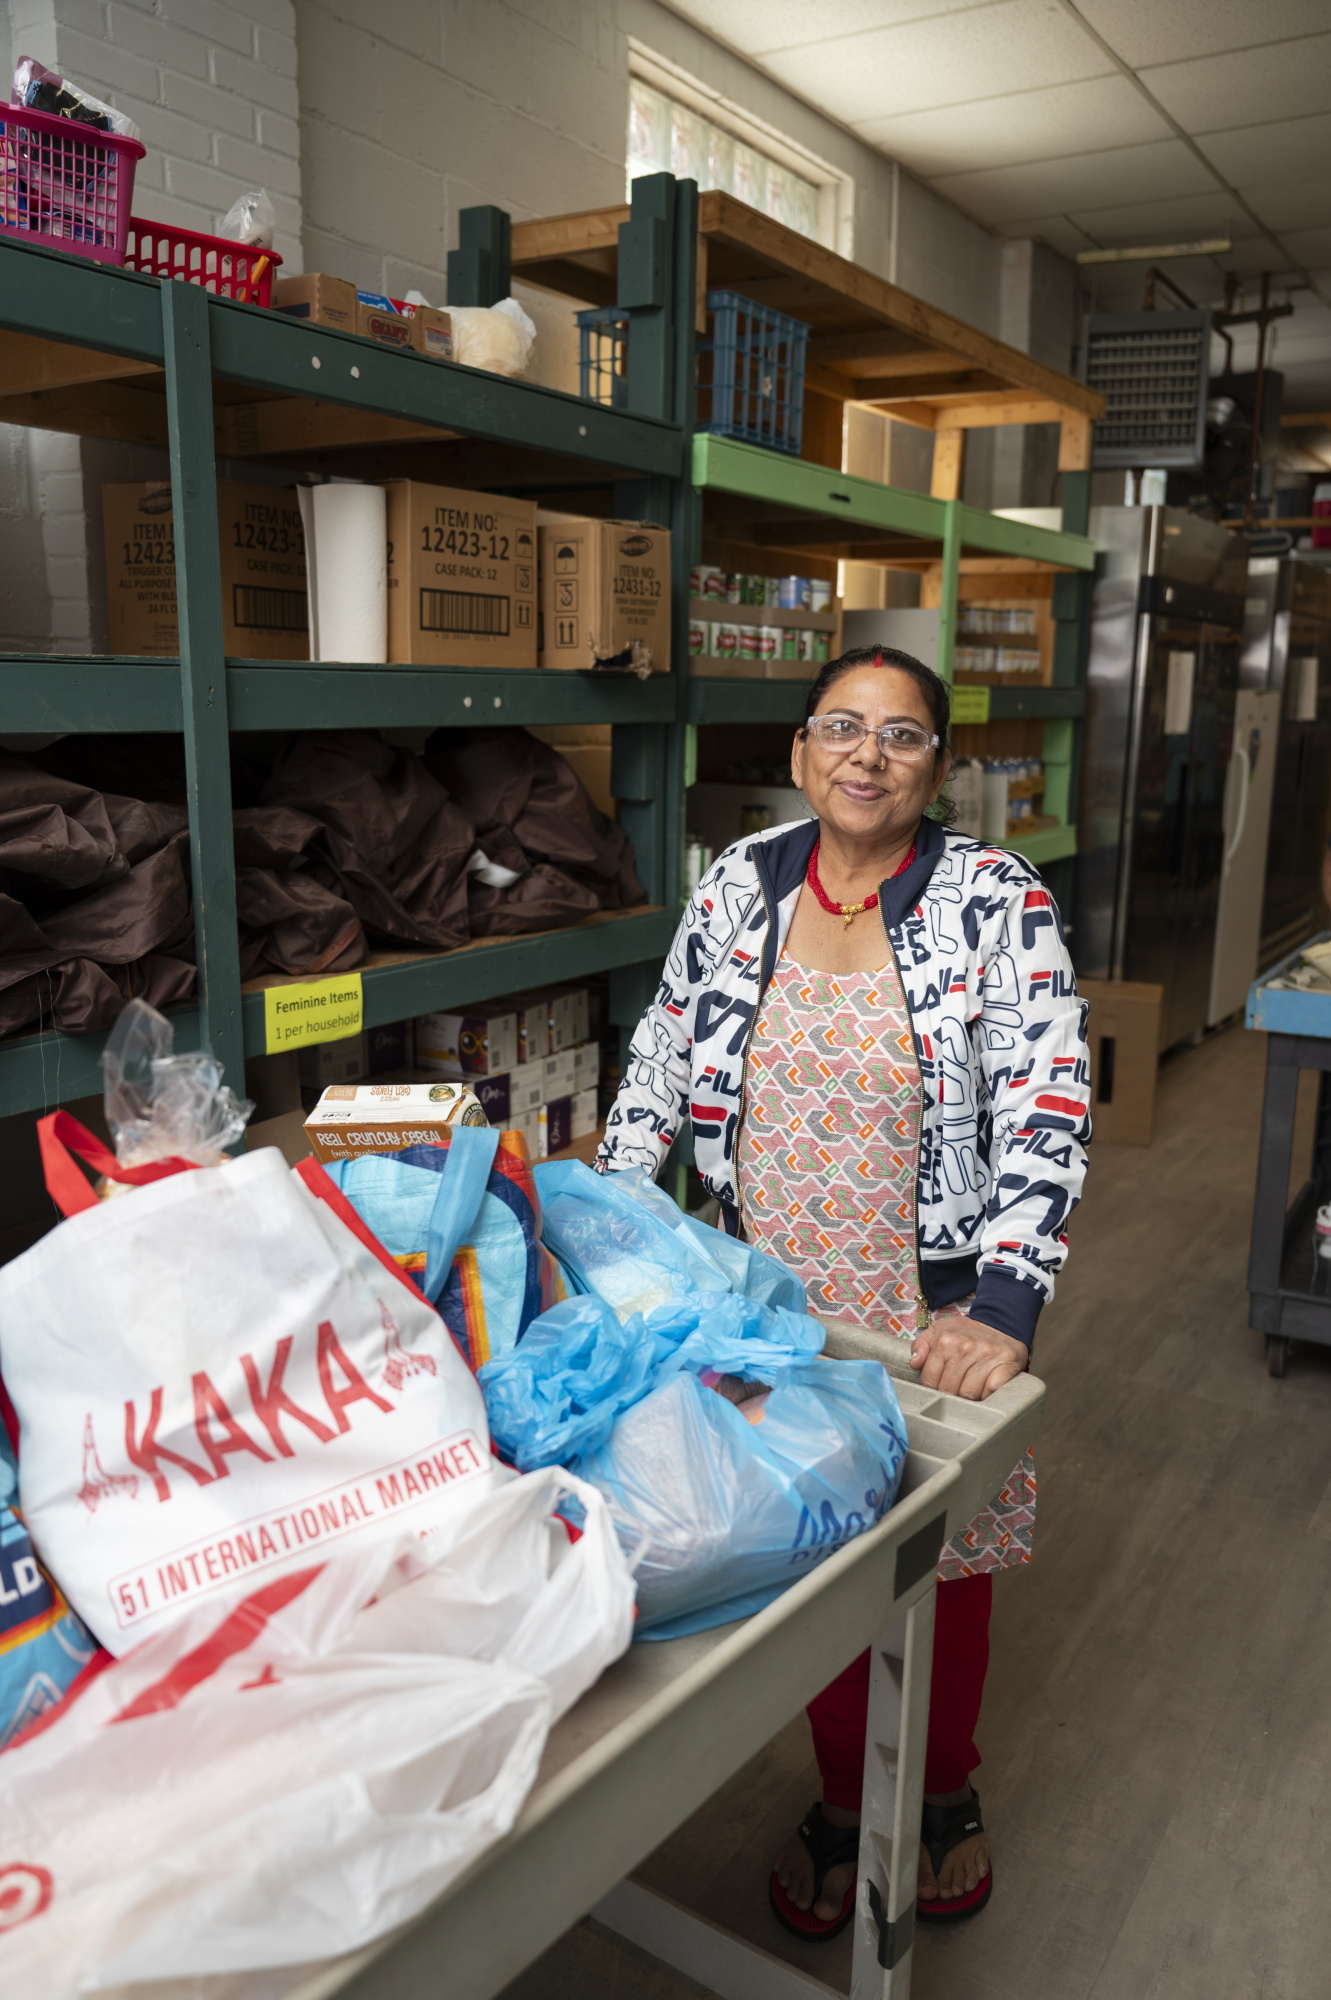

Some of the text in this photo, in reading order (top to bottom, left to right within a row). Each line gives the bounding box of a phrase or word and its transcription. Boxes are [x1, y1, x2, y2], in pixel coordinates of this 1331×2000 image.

[371, 319, 408, 342] GIANT
[245, 503, 301, 528] ITEM NO
[435, 507, 498, 532] ITEM NO:
[133, 523, 166, 541] ITEM
[233, 522, 306, 556] 12423-1
[421, 525, 510, 561] 12423-12
[122, 541, 176, 565] 12423
[127, 566, 162, 577] TRIGGER
[247, 558, 268, 573] CASE
[435, 562, 497, 581] CASE PACK: 12
[619, 564, 639, 578] ITEM
[118, 579, 172, 590] ALL PURPOSE
[613, 577, 661, 597] 12431-12
[137, 592, 160, 602] WITH
[148, 604, 178, 615] 24 FL O
[276, 990, 359, 1015] Feminine Items
[276, 1010, 360, 1041] 1 per household
[694, 1065, 742, 1099] FIL
[1050, 1057, 1092, 1088] FIL
[481, 1085, 500, 1104] One
[330, 1148, 353, 1159] (with
[1005, 1129, 1073, 1169] FILA
[124, 1320, 395, 1502] KAKA
[118, 1436, 483, 1618] 51 INTERNATIONAL MARKET
